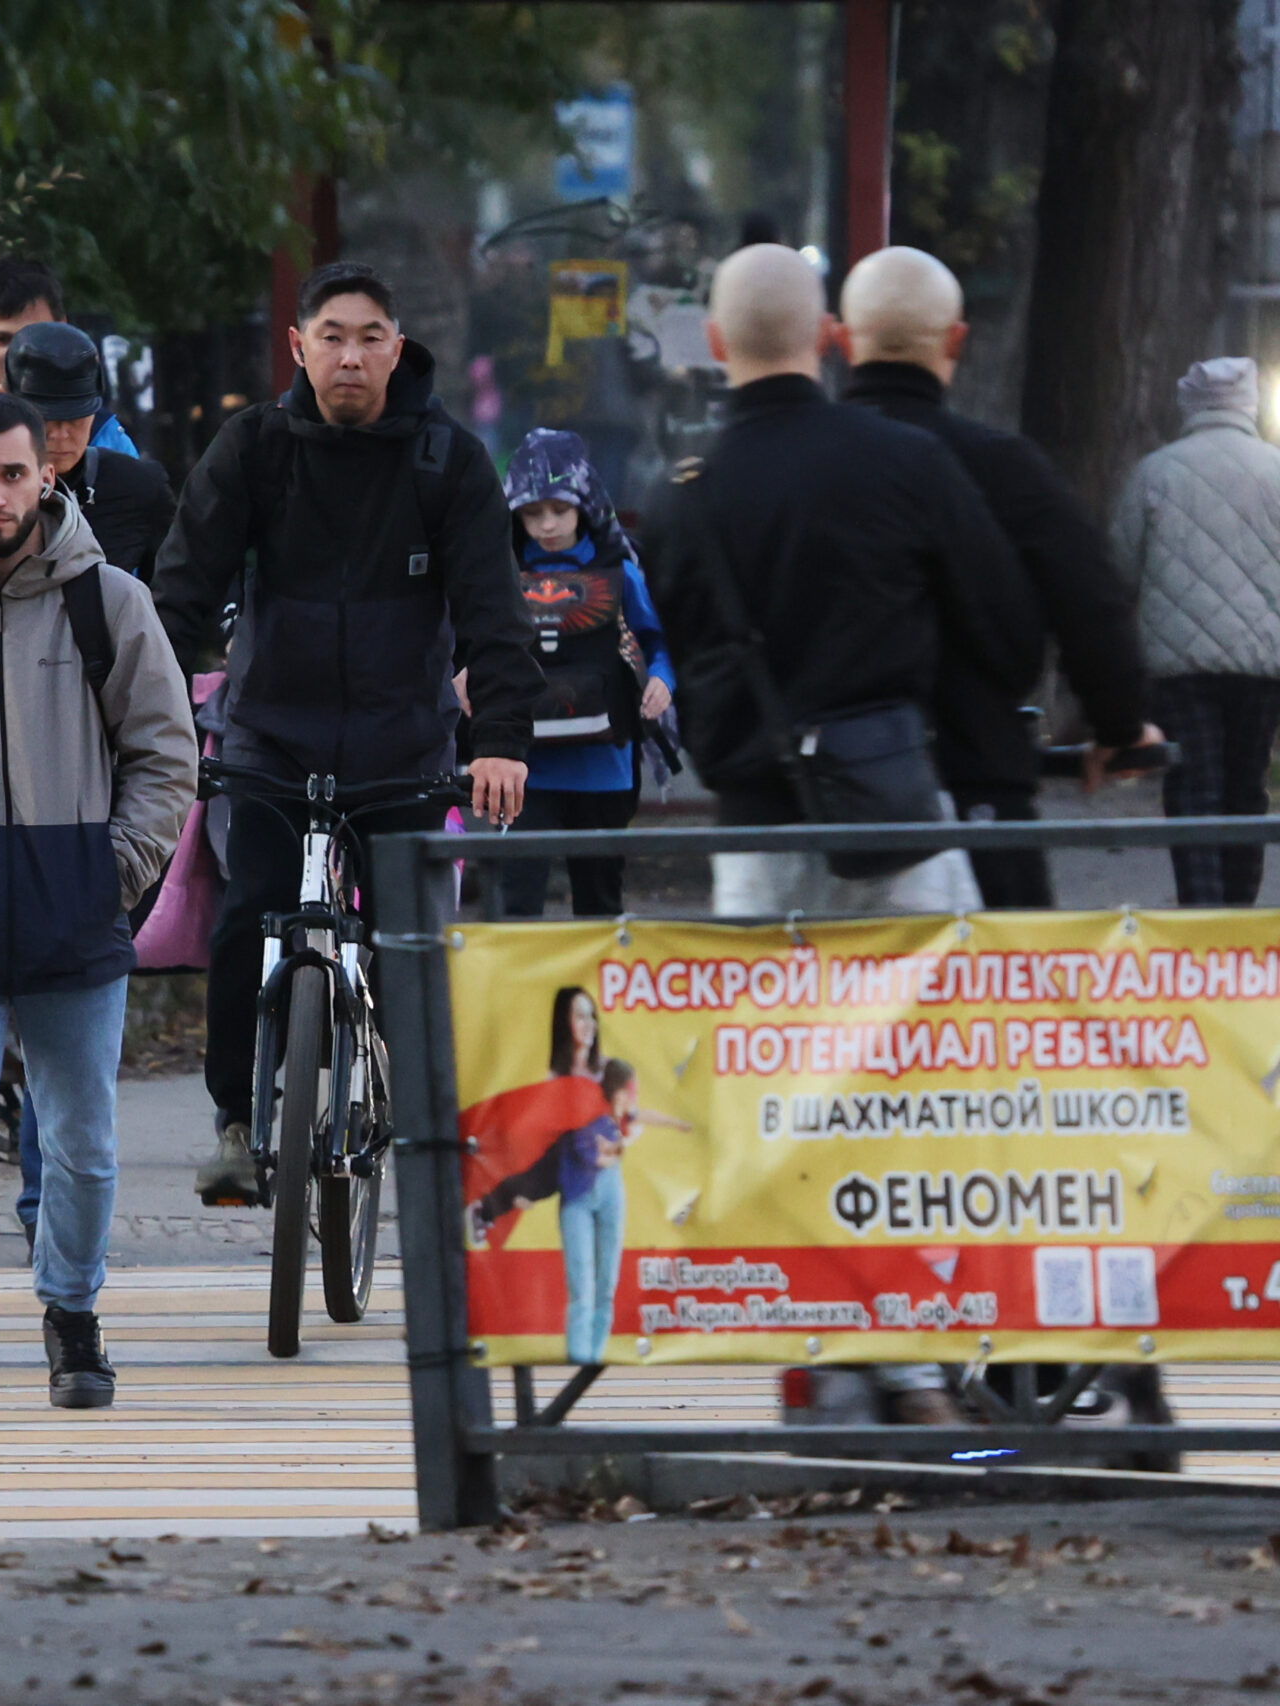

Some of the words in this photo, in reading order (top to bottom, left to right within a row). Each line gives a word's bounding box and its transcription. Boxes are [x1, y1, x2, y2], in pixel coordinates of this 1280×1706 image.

[600, 947, 819, 1009] РАСКРОЙ
[829, 951, 1278, 1003] ИНТЕЛЛЕКТУАЛЬНЫ
[716, 1020, 997, 1075] ПОТЕНЦИАЛ
[1006, 1015, 1208, 1068] РЕБЕНКА
[762, 1098, 782, 1135] В
[792, 1083, 1043, 1134] ШАХМАТНОЙ
[1051, 1091, 1188, 1130] ШКОЛЕ
[833, 1174, 1120, 1230] ФЕНОМЕН
[677, 1296, 743, 1332] Карла
